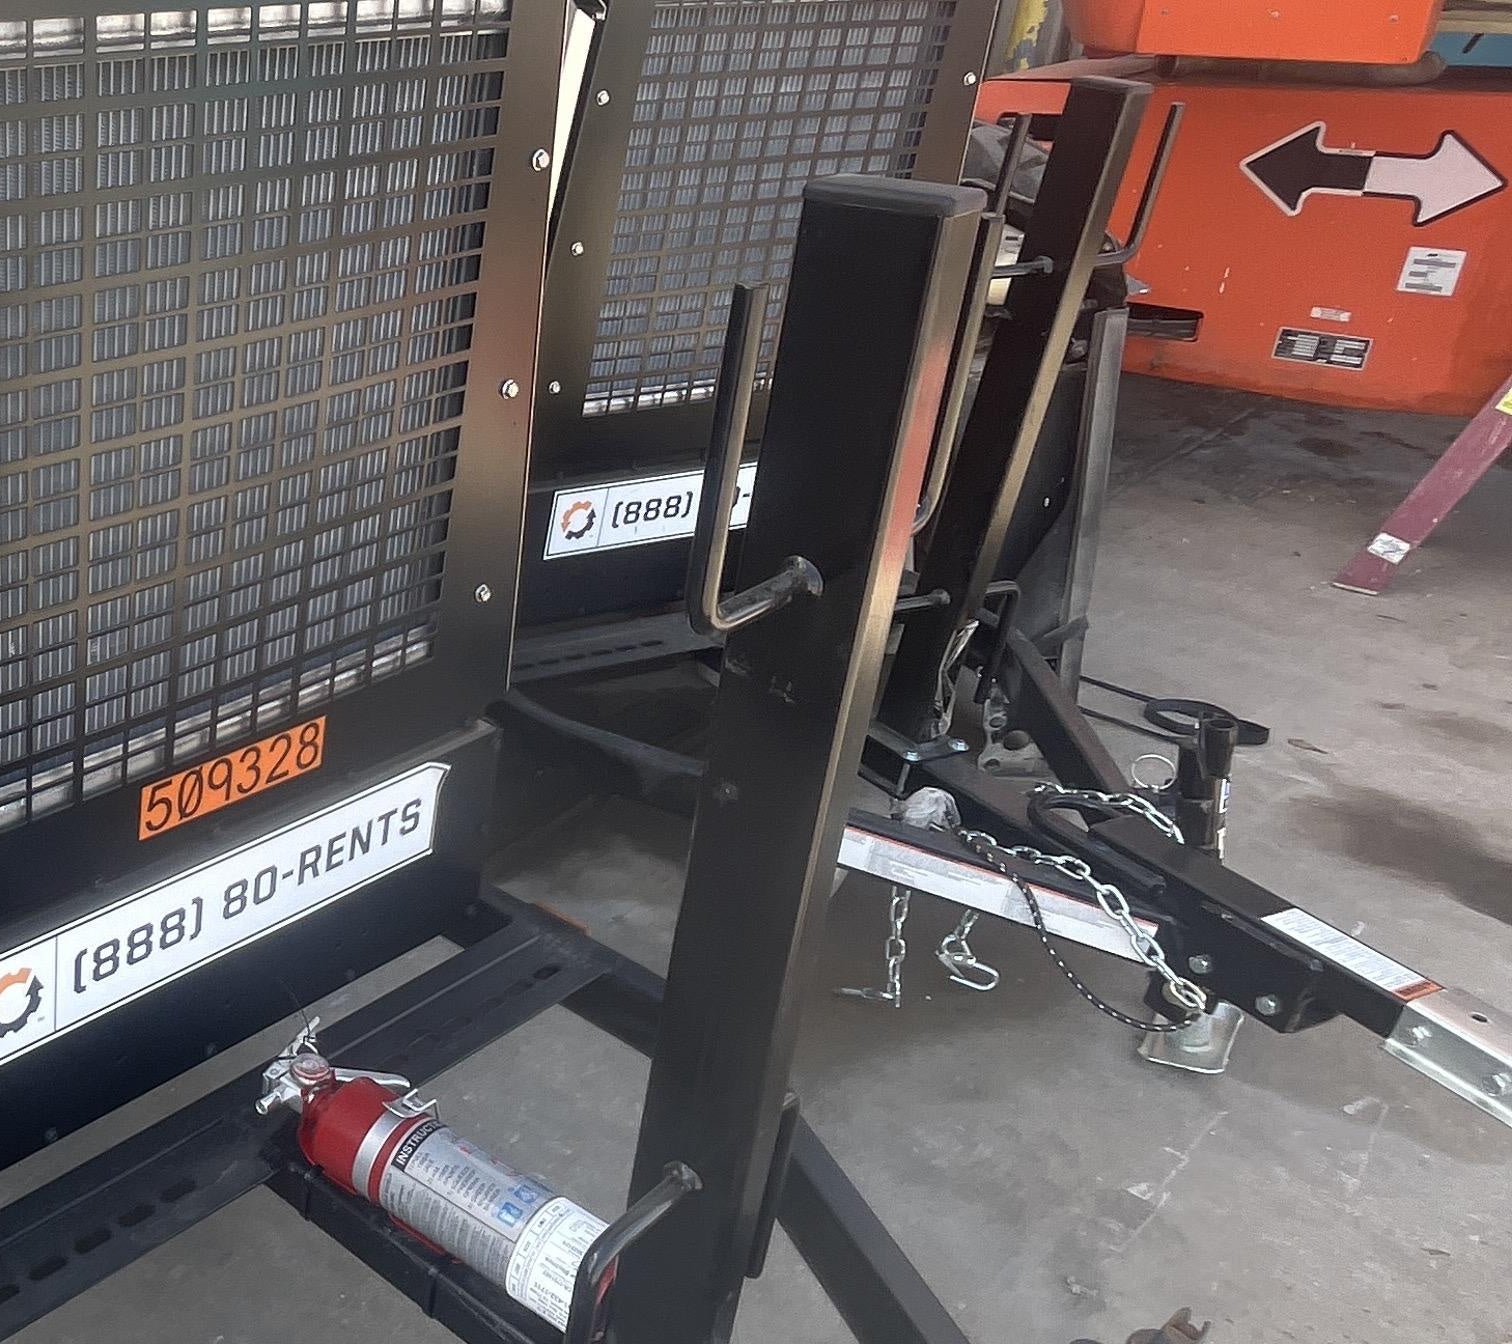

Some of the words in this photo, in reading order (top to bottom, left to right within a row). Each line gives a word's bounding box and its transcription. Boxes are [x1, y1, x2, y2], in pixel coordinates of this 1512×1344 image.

[612, 490, 693, 529] (888)
[143, 721, 321, 834] 509328
[73, 896, 203, 994] (888)
[223, 797, 422, 920] 80-RENTS
[396, 1120, 442, 1166] INSTRUCT
